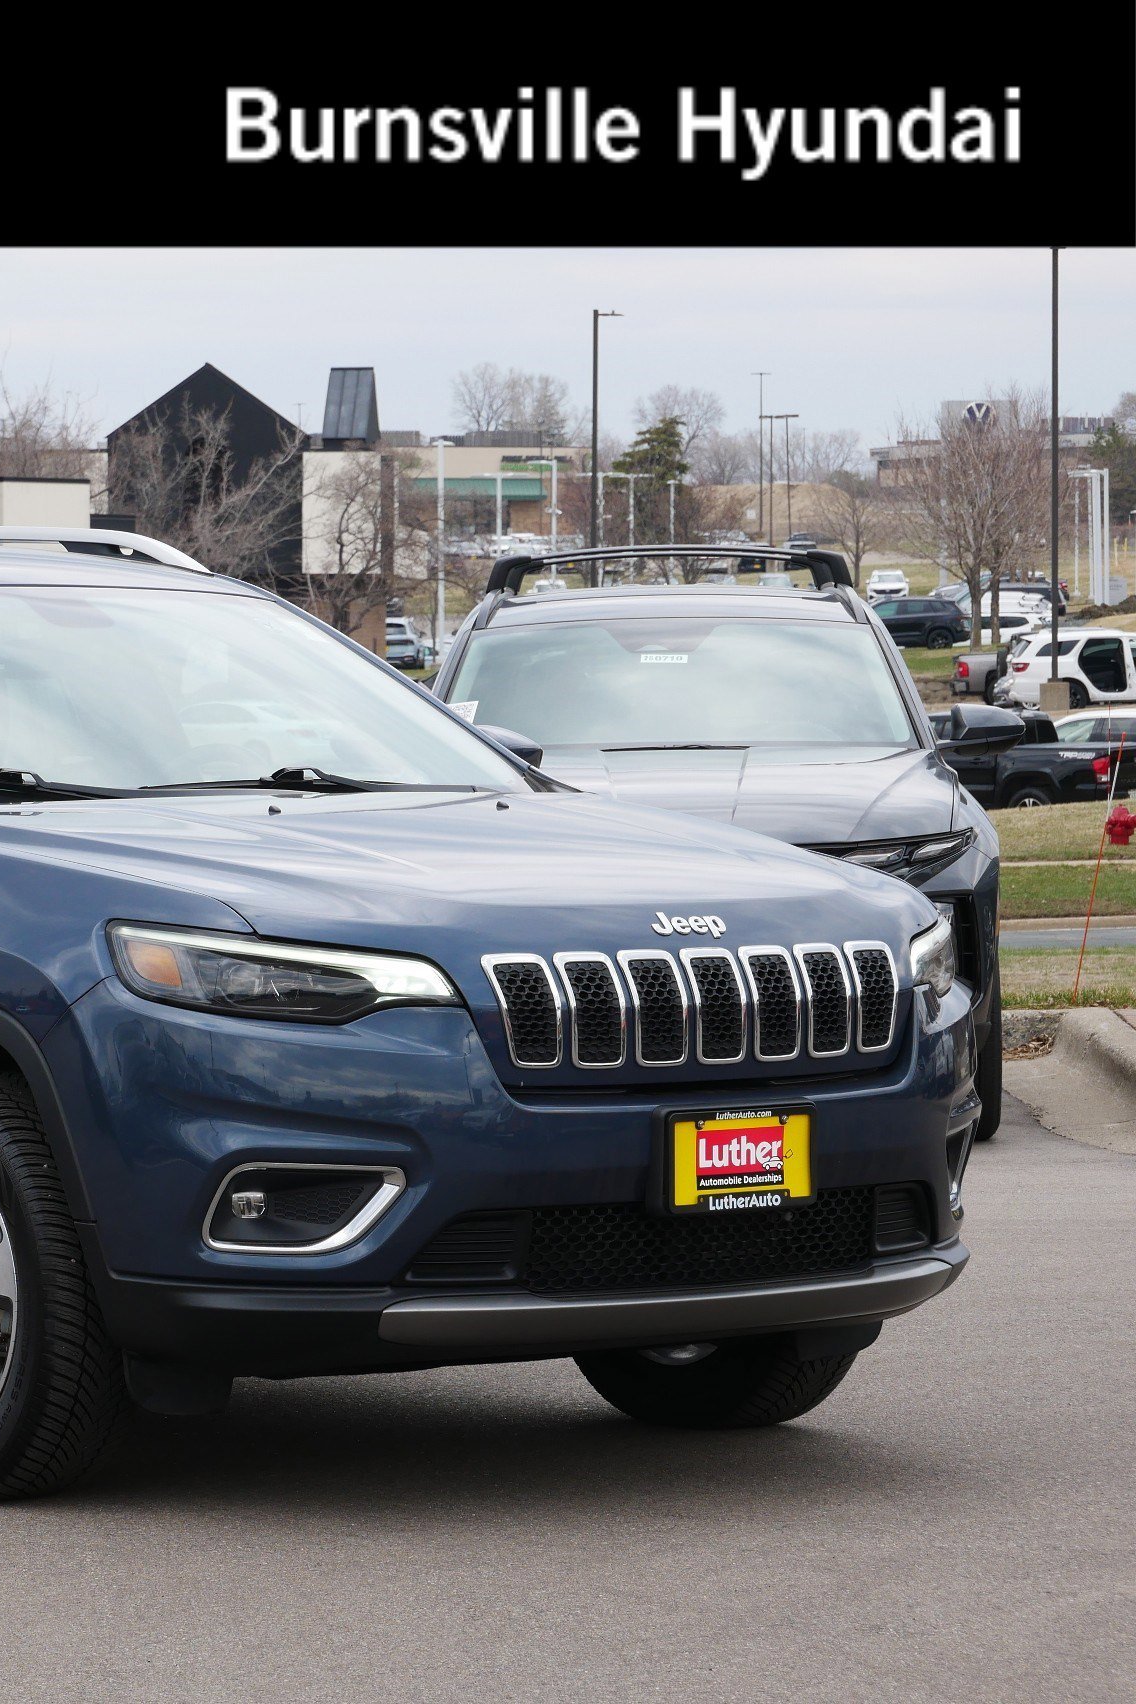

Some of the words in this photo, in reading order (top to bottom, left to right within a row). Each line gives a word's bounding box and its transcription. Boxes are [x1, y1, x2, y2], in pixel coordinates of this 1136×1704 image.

[651, 911, 727, 939] Jeep
[715, 1110, 772, 1121] LutherAuto.com
[698, 1135, 782, 1169] Luther
[699, 1175, 743, 1187] Automobile
[743, 1173, 783, 1185] Dealerships
[708, 1192, 781, 1212] LutherAuto
